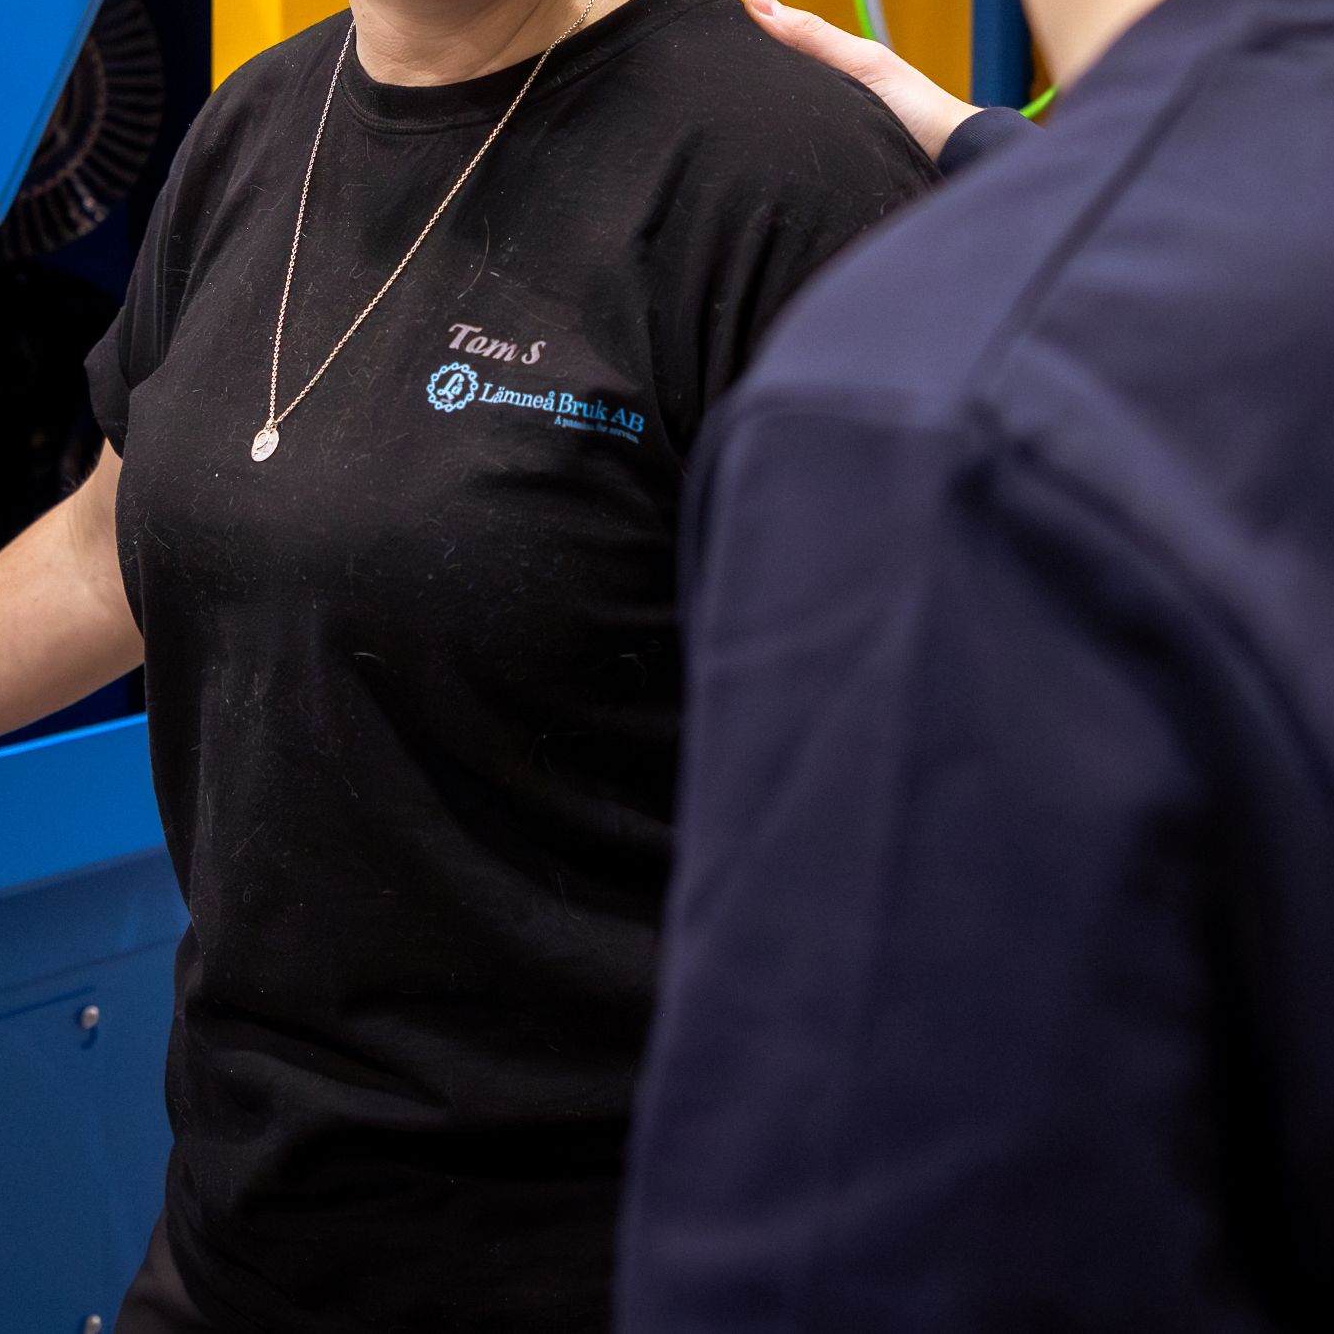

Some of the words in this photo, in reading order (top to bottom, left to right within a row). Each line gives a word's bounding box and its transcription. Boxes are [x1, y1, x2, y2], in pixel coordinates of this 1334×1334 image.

[479, 382, 555, 412] Lämneå
[556, 392, 609, 421] Bruk
[610, 407, 646, 433] AB
